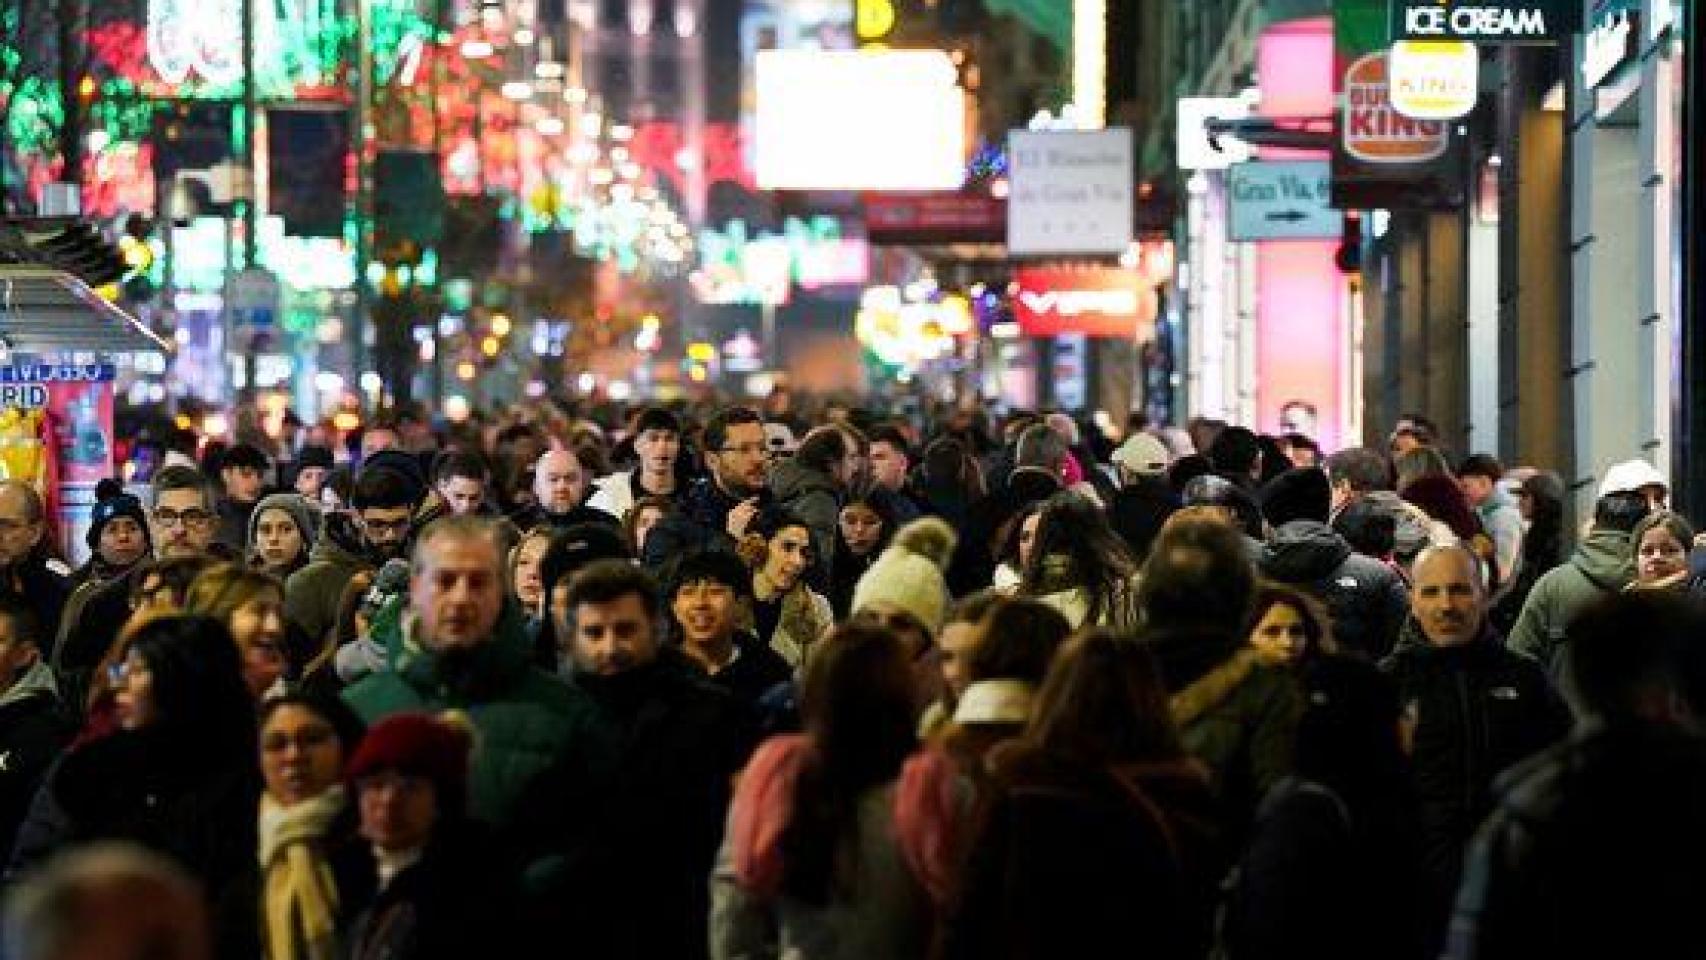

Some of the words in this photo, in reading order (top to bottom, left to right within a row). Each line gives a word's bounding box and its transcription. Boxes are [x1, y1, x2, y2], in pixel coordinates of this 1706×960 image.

[1405, 7, 1446, 34] ICE
[1451, 7, 1545, 34] CREAM
[3, 386, 46, 406] RID
